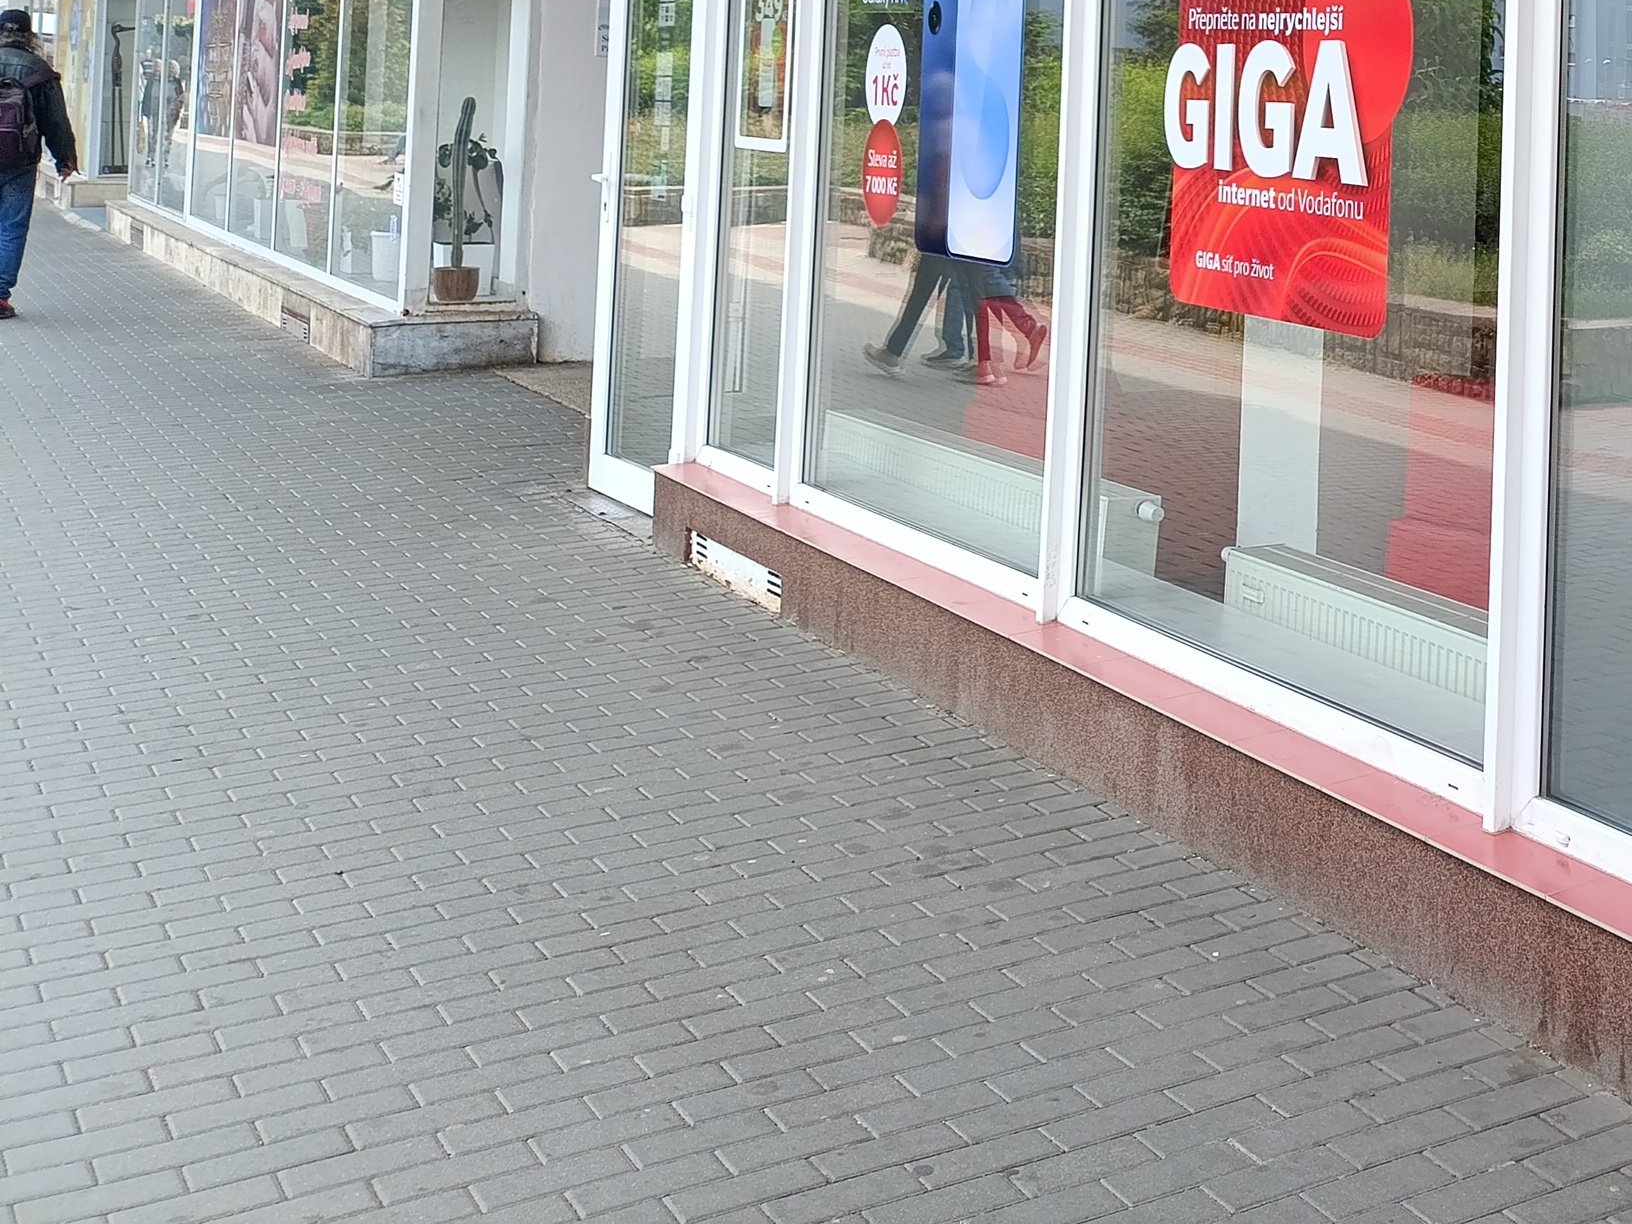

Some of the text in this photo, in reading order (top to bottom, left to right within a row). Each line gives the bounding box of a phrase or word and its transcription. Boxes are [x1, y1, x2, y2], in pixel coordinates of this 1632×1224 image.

[1188, 5, 1344, 36] Přepněte na nejrychlejší
[873, 74, 899, 107] 1 Kč
[1164, 39, 1369, 187] GIGA
[868, 149, 898, 169] Sleva až
[872, 176, 886, 194] 000
[887, 177, 898, 195] Kč
[1218, 179, 1364, 220] internet od Vodafonu
[1195, 250, 1274, 280] GIGA síť pro život
